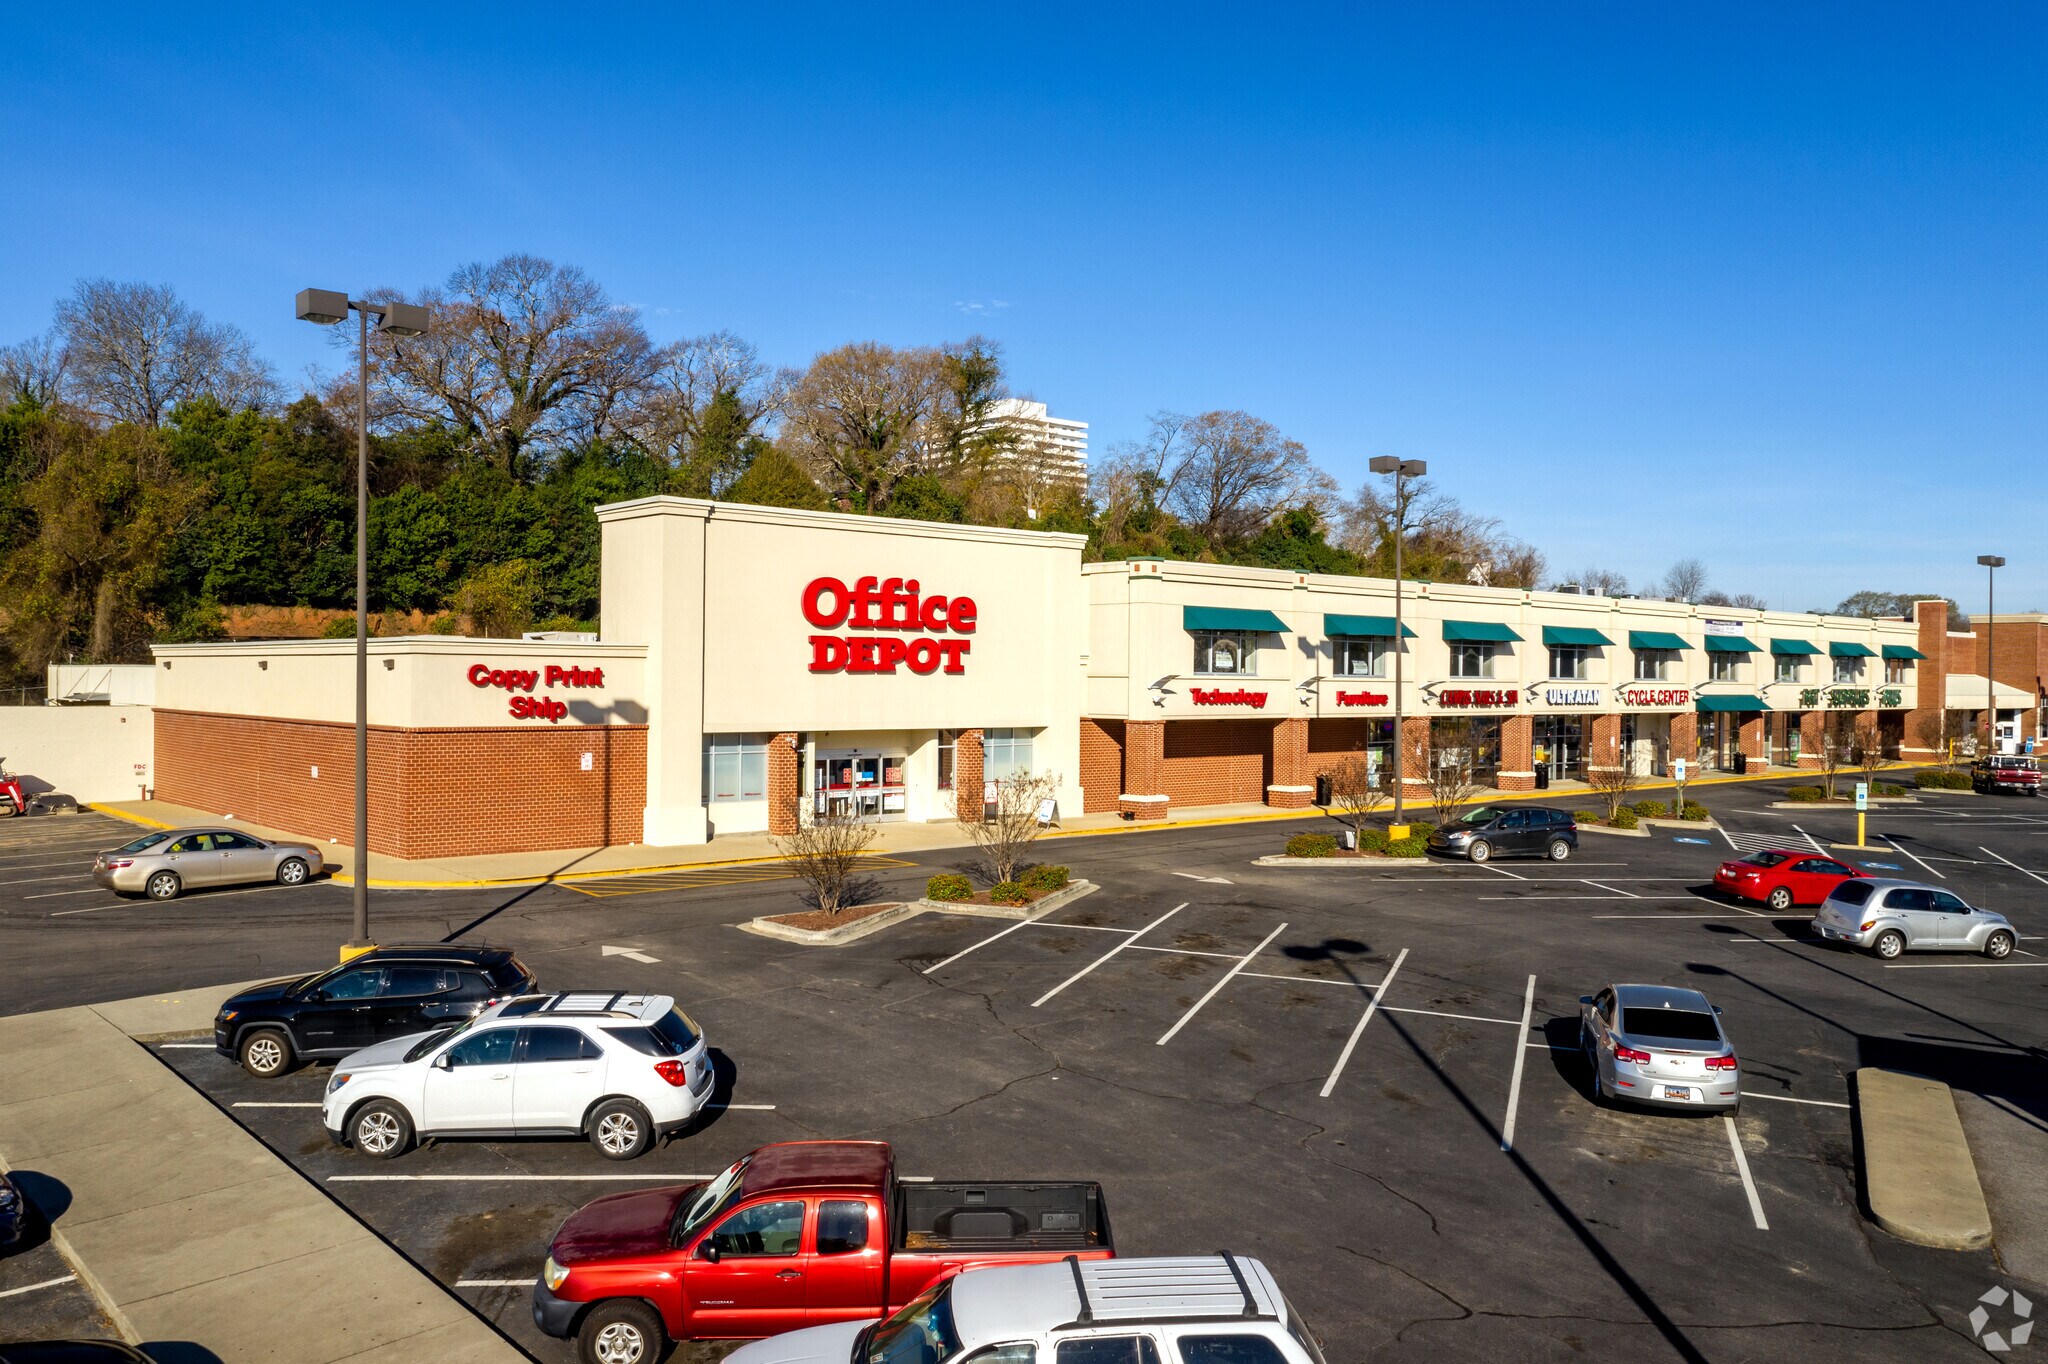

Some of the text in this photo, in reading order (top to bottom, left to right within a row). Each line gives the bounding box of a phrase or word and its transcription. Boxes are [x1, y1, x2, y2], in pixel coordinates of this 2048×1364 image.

[802, 576, 977, 632] Office
[808, 635, 971, 674] DEPOT
[467, 664, 604, 691] Copy Print
[1189, 688, 1268, 708] Technology
[1336, 690, 1389, 707] Furniture
[1546, 689, 1600, 705] ULTRATAN
[1627, 689, 1689, 704] CYCLE CENTER
[508, 696, 568, 723] Ship
